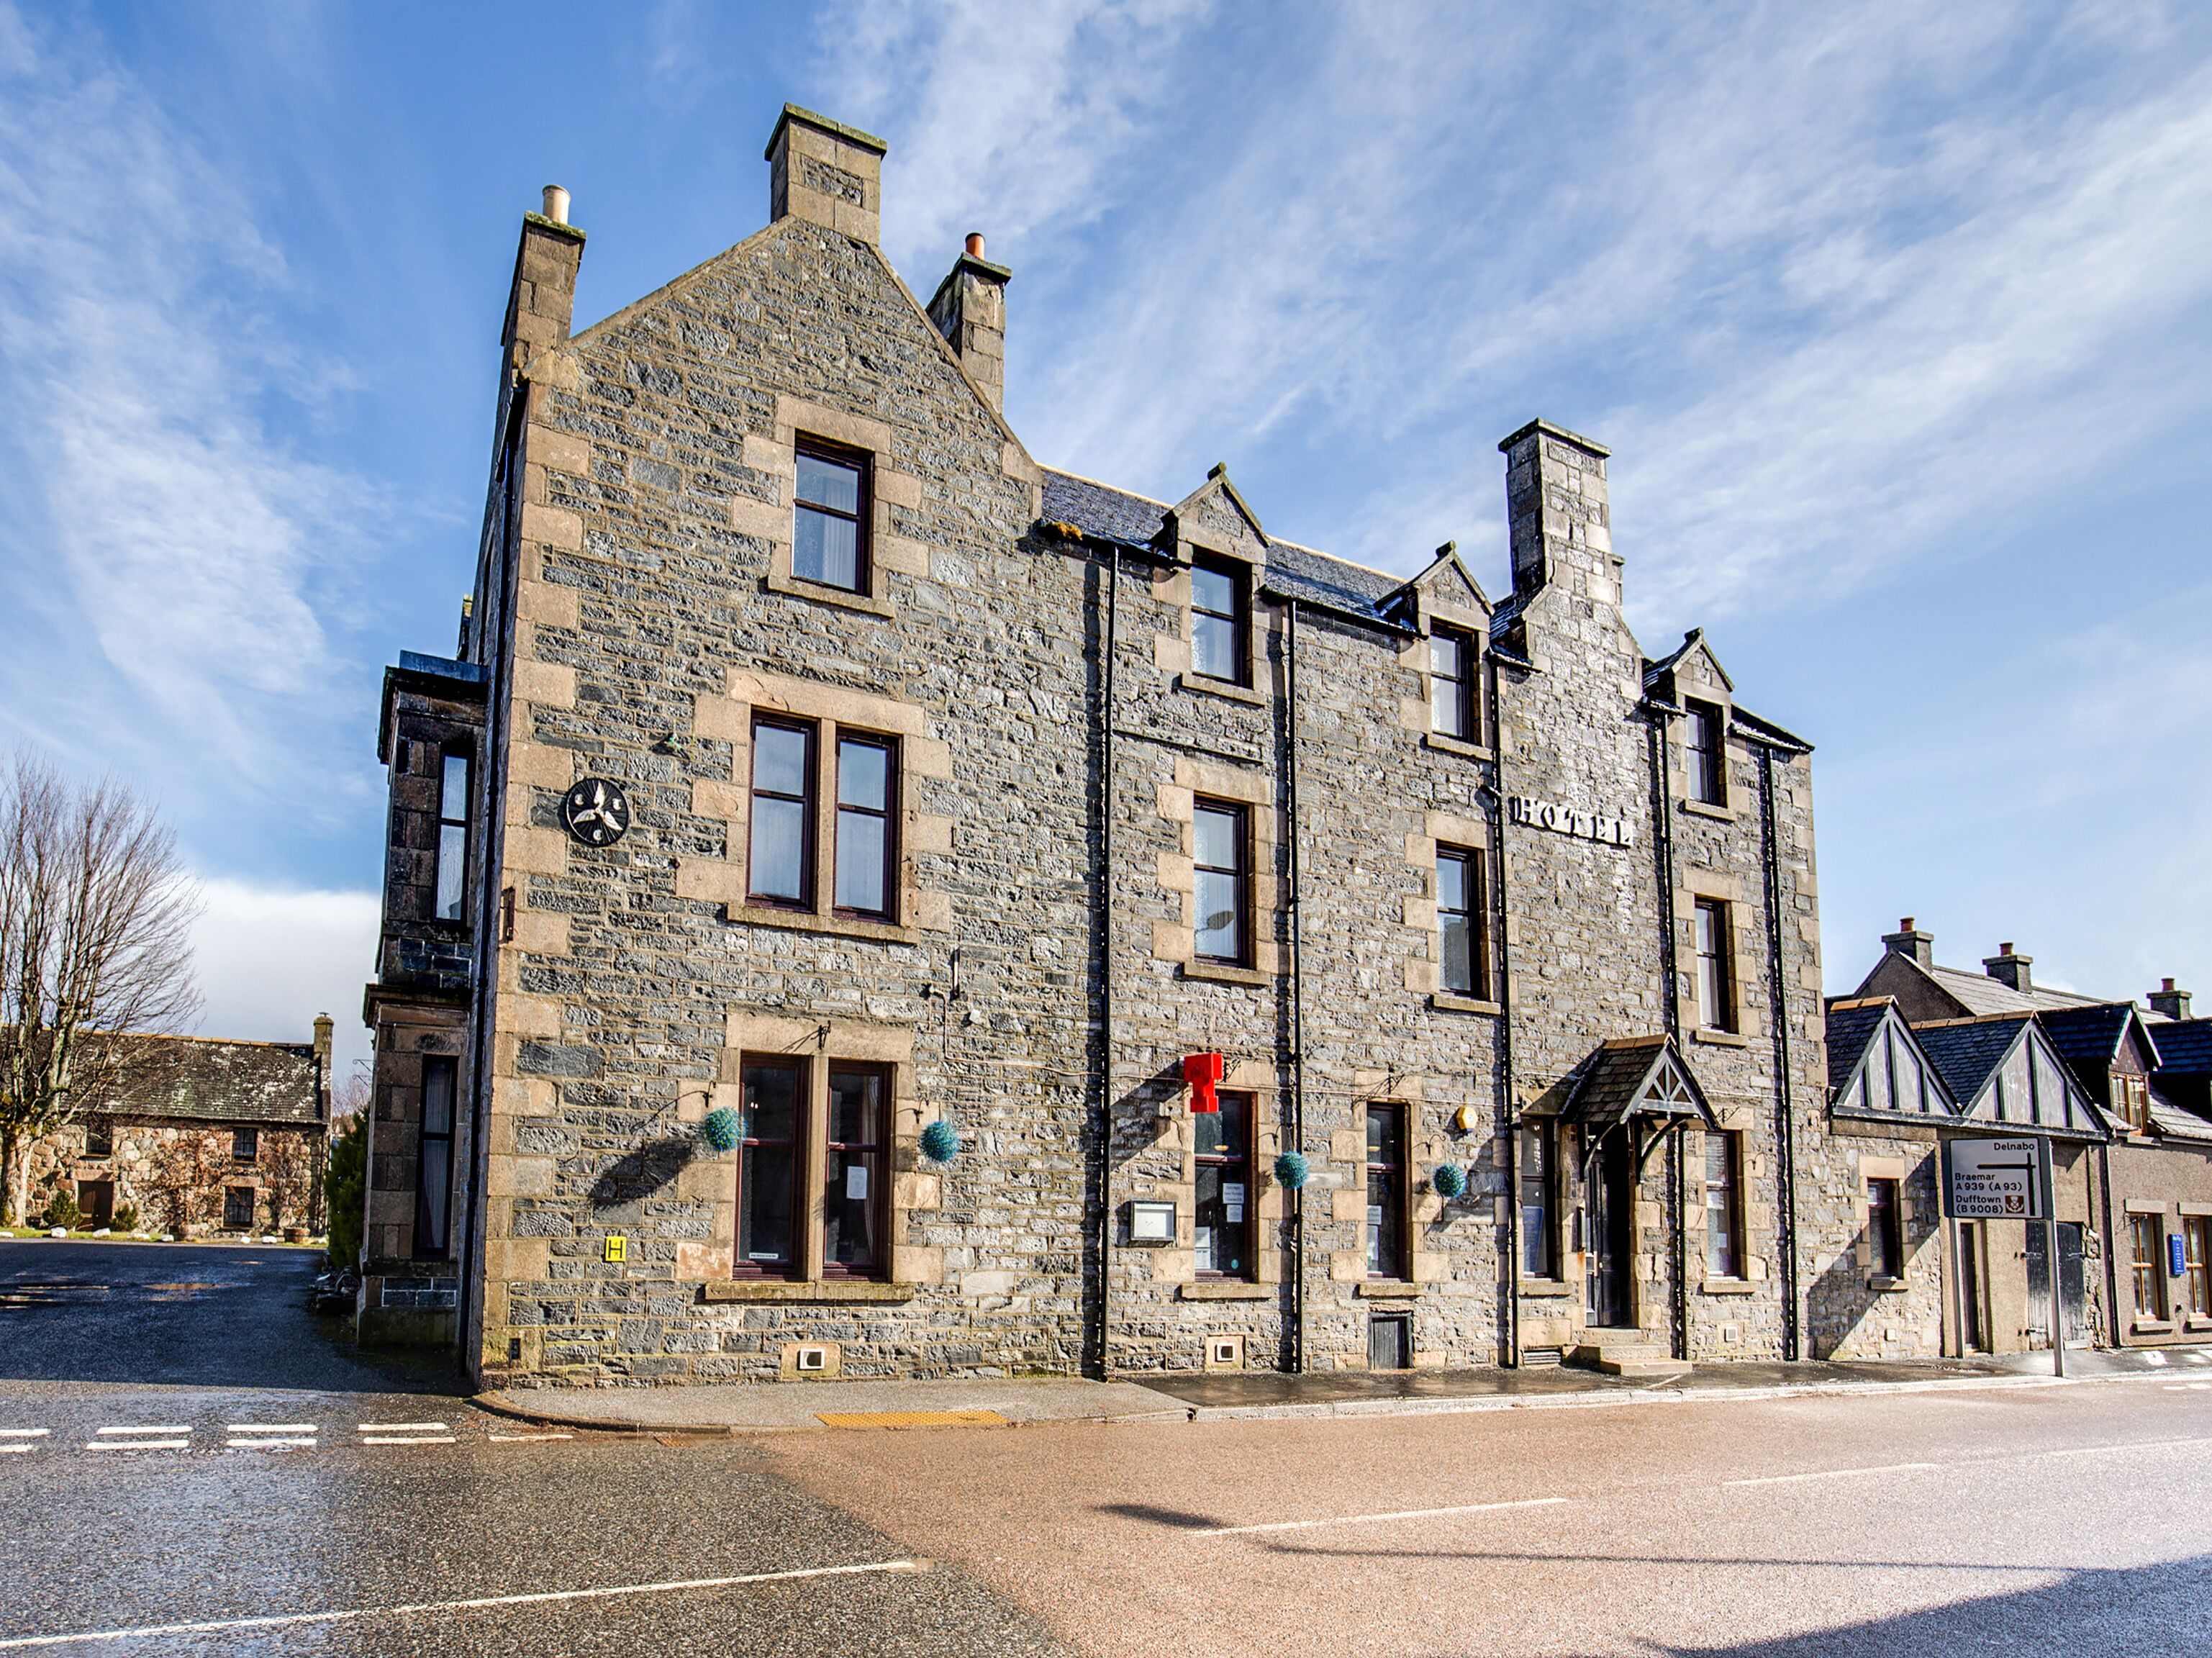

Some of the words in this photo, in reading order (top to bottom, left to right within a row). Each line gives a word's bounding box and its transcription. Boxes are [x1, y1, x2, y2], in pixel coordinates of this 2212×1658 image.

[1510, 794, 1634, 848] HOTEL
[1994, 1142, 2035, 1151] Delnabo
[1954, 1172, 1995, 1181] Braemar
[1956, 1195, 2001, 1203] Dufftown
[608, 1239, 623, 1259] H
